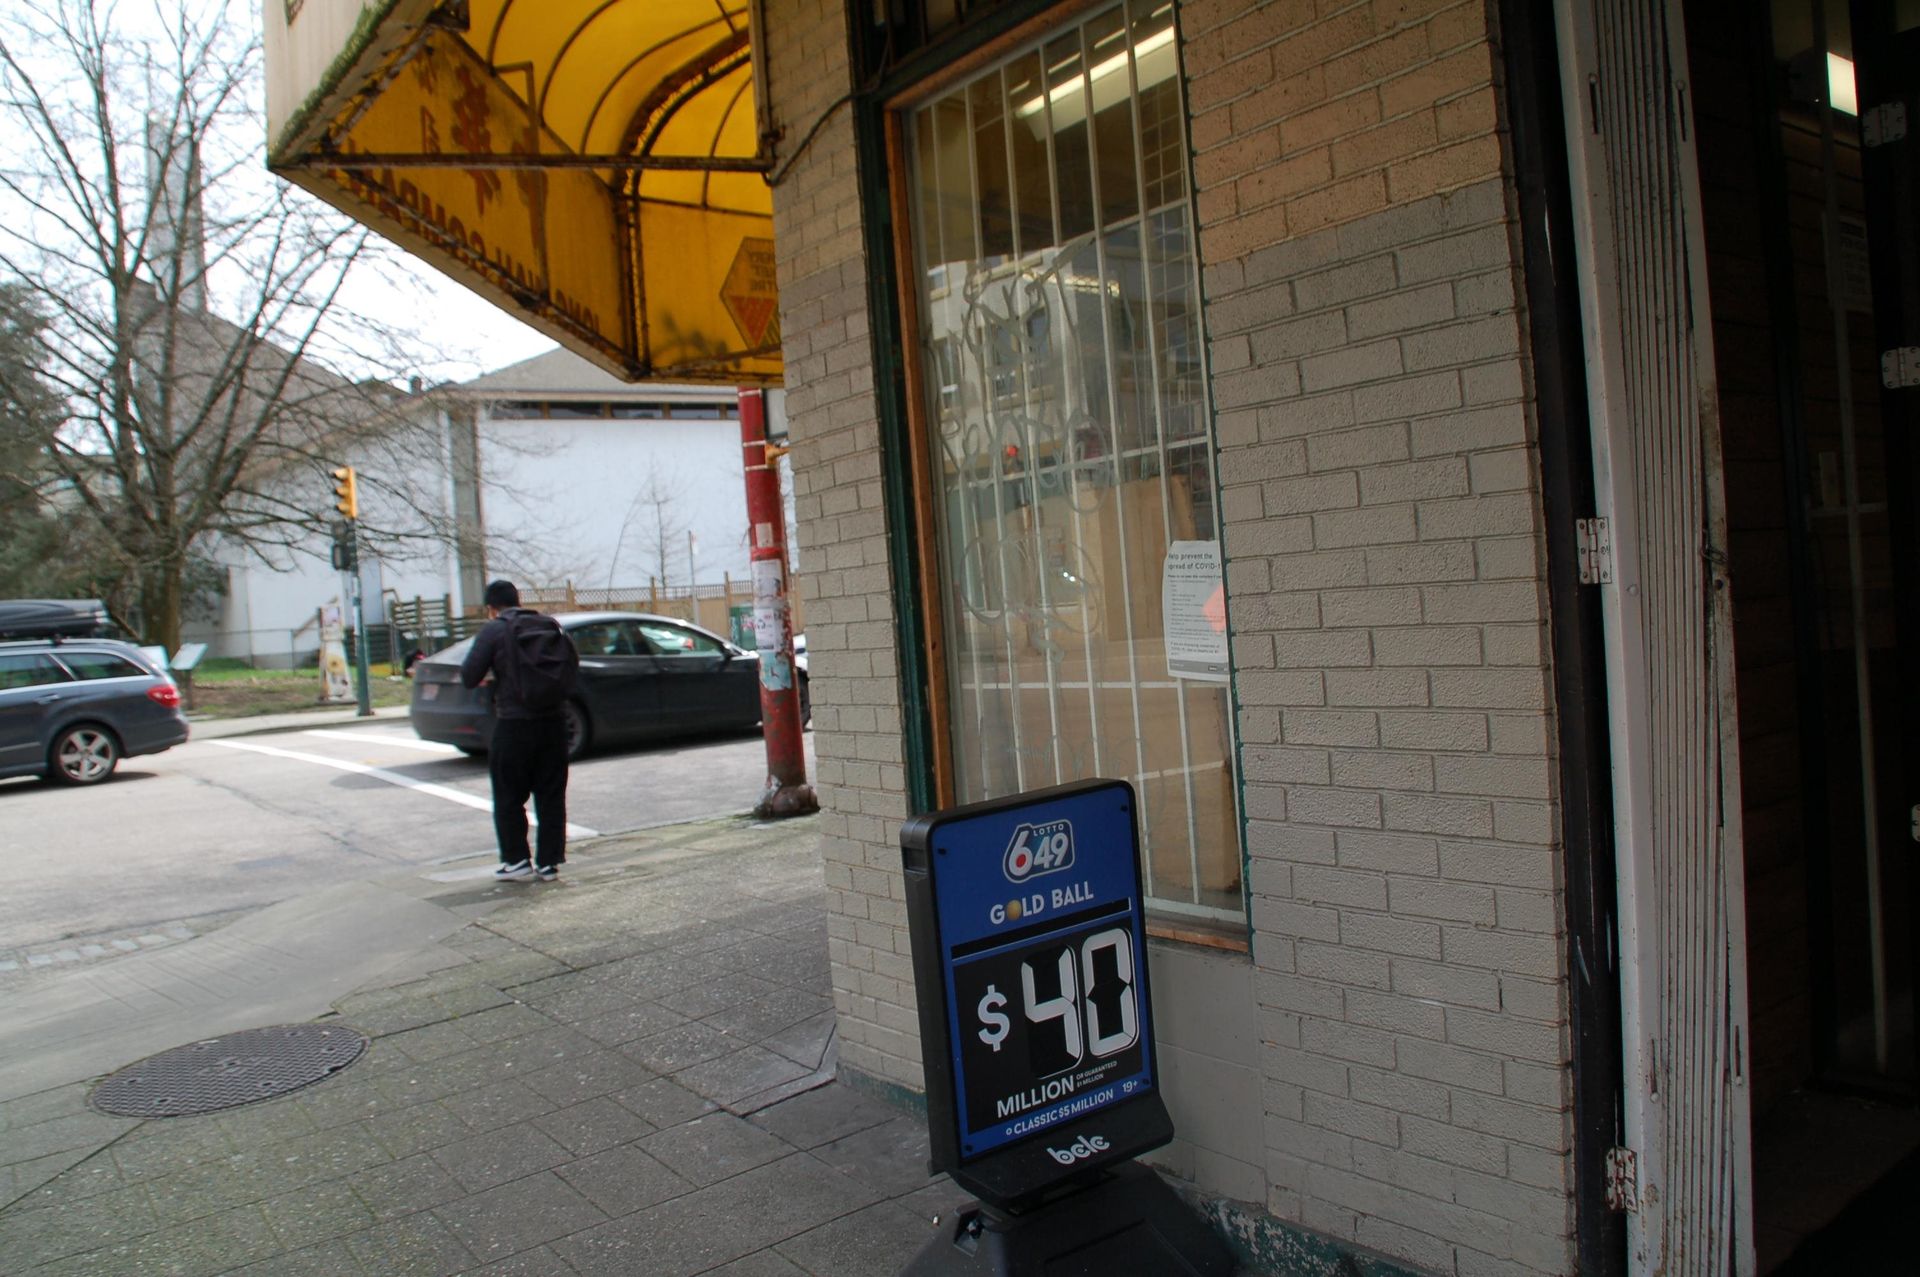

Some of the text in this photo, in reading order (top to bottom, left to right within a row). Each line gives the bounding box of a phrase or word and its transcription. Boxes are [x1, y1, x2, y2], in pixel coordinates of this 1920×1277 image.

[1181, 552, 1203, 561] prevent
[1204, 552, 1213, 560] the
[1187, 562, 1194, 570] of
[1033, 824, 1064, 836] LOTTO
[1051, 881, 1094, 909] BALL
[1021, 927, 1137, 1061] 40
[1084, 1061, 1118, 1077] GUARANTEED
[1083, 1073, 1105, 1086] MILLION
[1122, 1080, 1138, 1093] 19+
[997, 1075, 1074, 1118] MILLION
[1013, 1088, 1114, 1135] CLASSIC $5 MILLION
